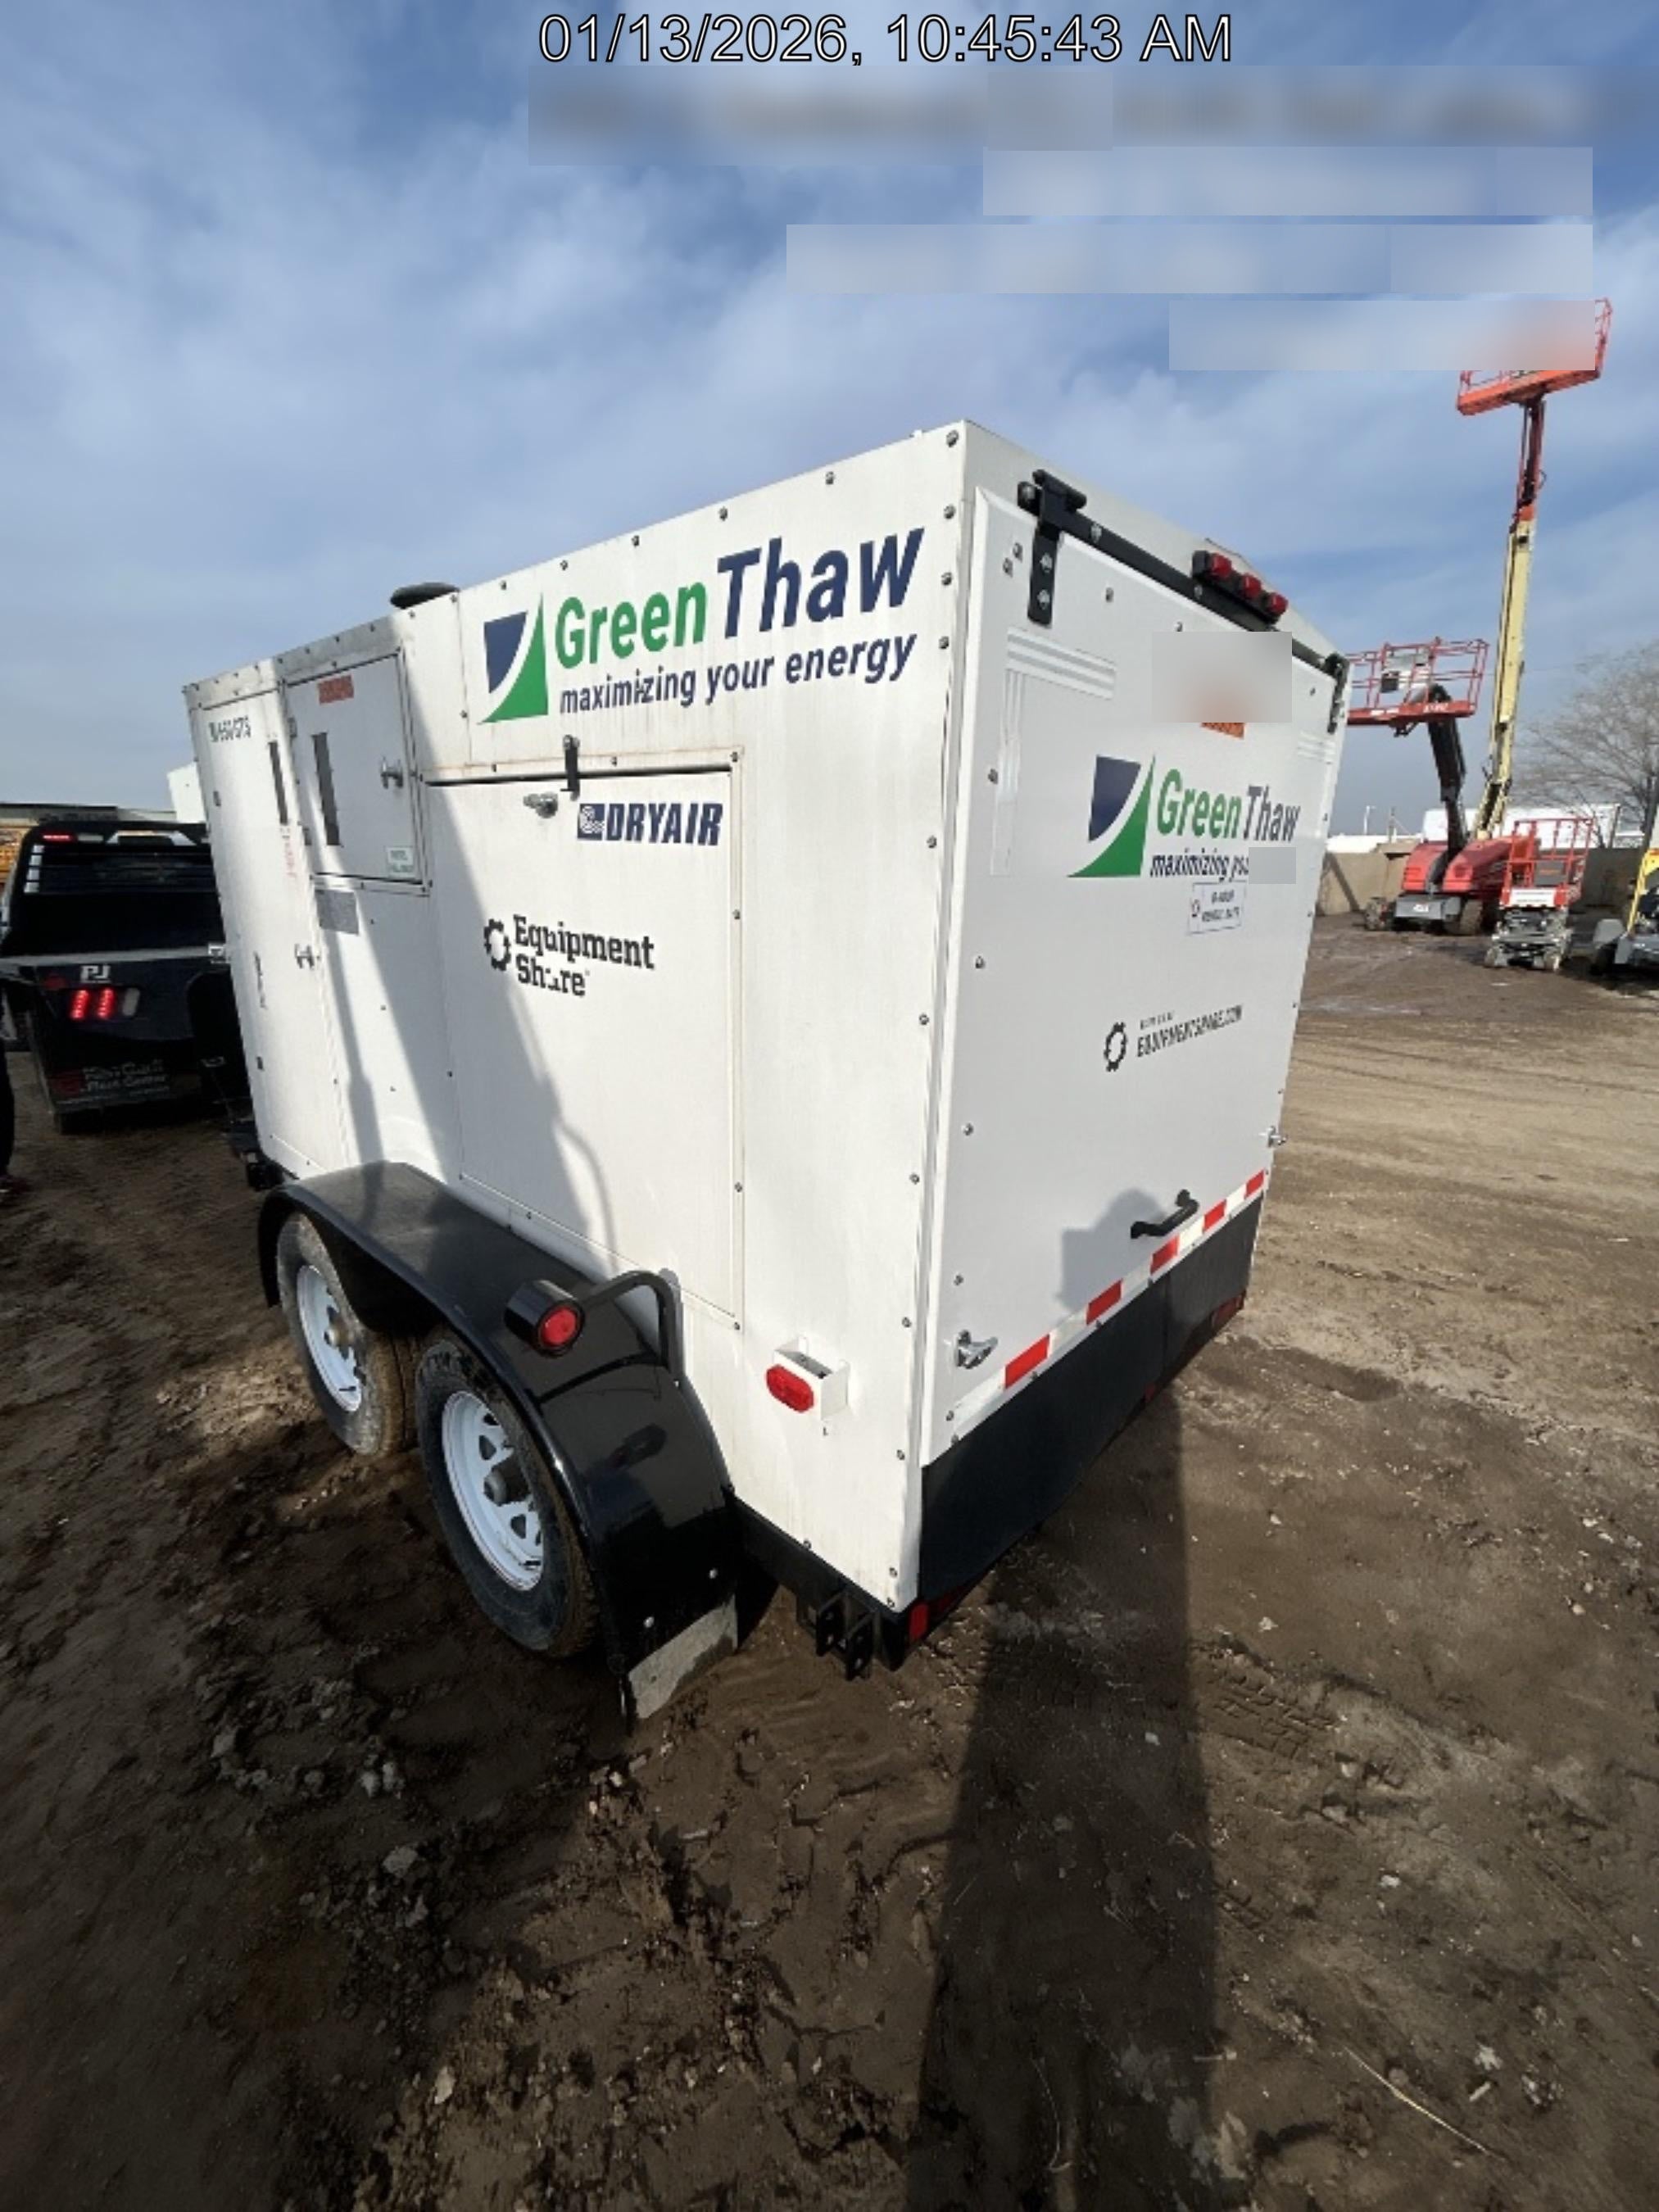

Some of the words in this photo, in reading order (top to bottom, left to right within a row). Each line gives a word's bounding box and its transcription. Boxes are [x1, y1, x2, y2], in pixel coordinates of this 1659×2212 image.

[560, 668, 696, 714] maximizing
[705, 656, 774, 705] your
[785, 633, 918, 685] energy
[605, 803, 723, 846] DRYAIR
[1149, 847, 1229, 882] maximizing
[513, 913, 655, 970] Equipment
